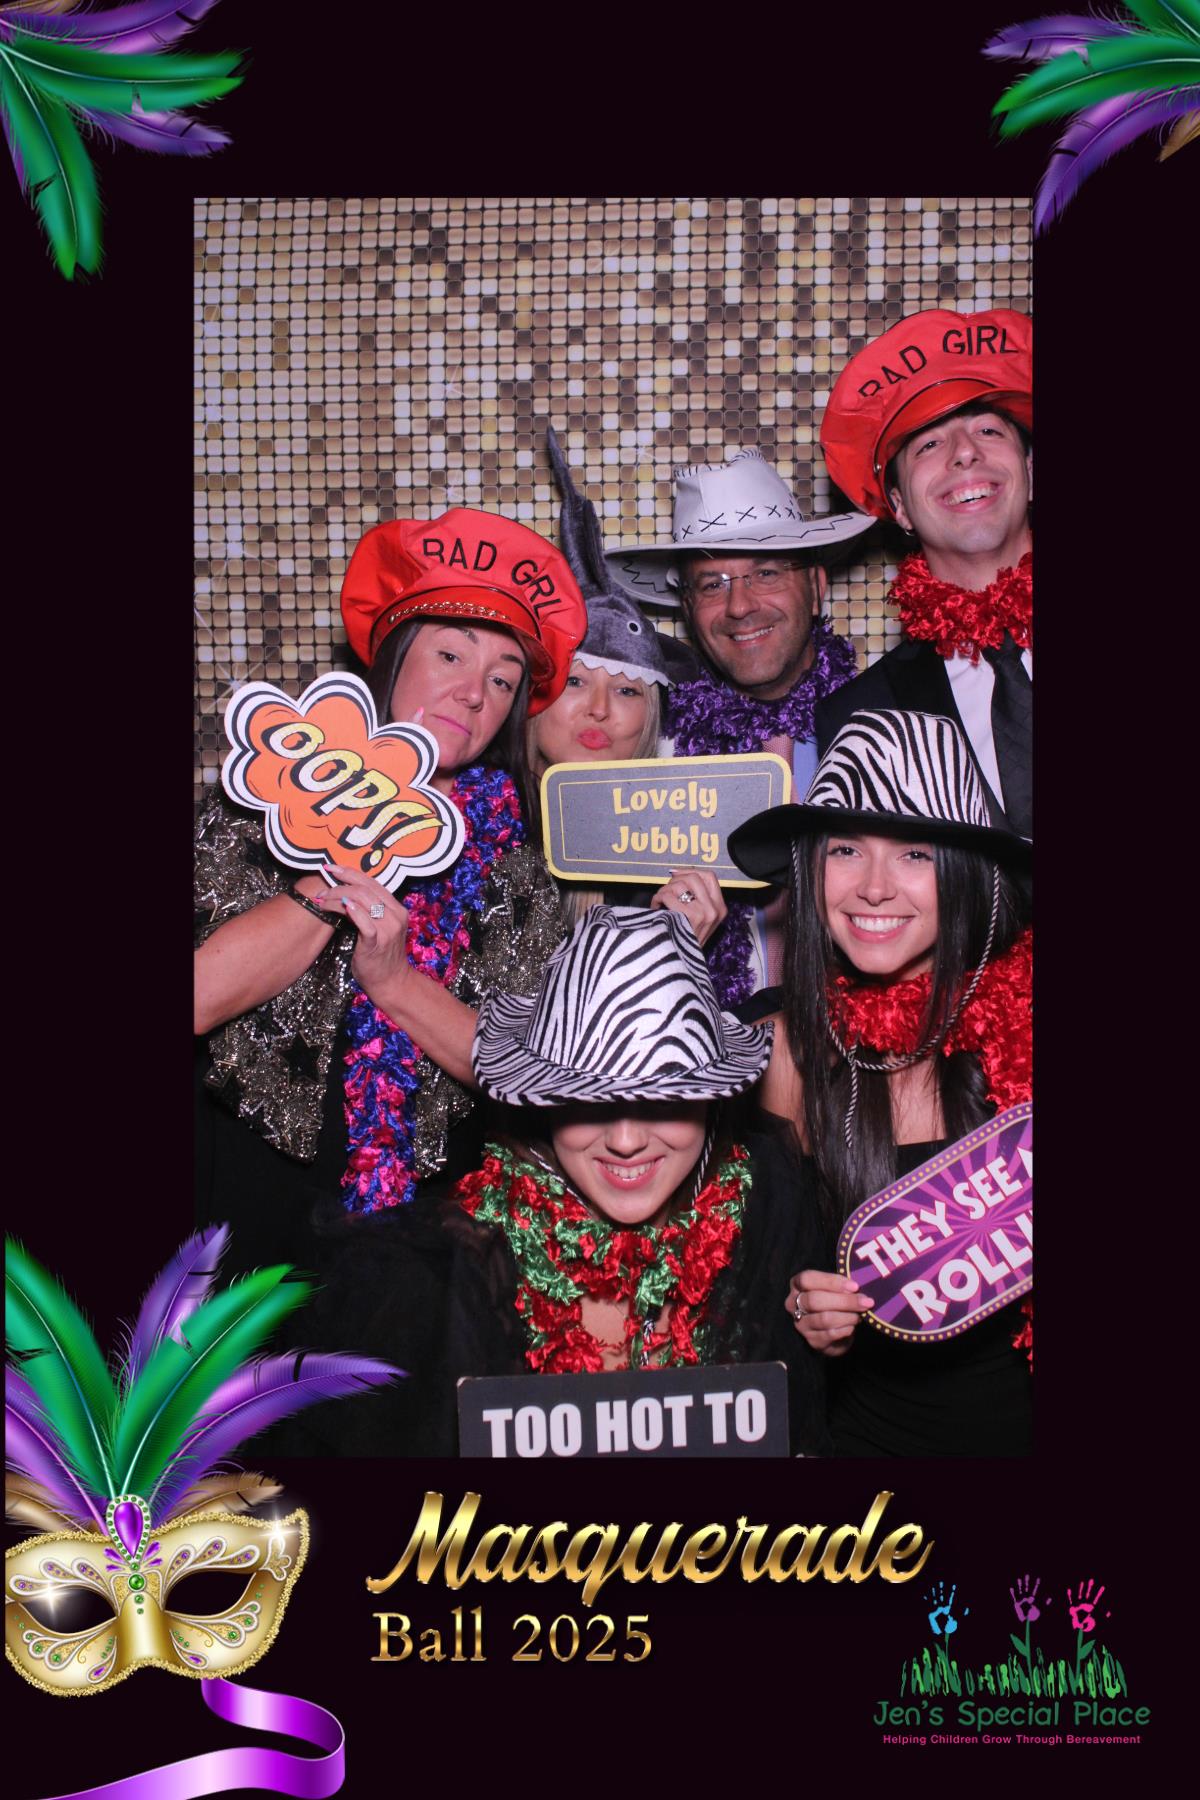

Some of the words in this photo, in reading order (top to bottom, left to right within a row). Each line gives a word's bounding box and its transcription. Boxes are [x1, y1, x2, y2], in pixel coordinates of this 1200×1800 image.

[942, 325, 1019, 355] GIRL
[511, 559, 562, 620] GRL
[261, 721, 448, 872] OOPS!
[612, 781, 718, 818] Lovely
[611, 825, 719, 863] Jubbly
[855, 1199, 954, 1278] THEY
[952, 1155, 1024, 1220] SEE
[900, 1209, 1033, 1324] ROLLI
[483, 1403, 582, 1457] TOO
[596, 1395, 693, 1453] HOT
[704, 1389, 767, 1443] TO
